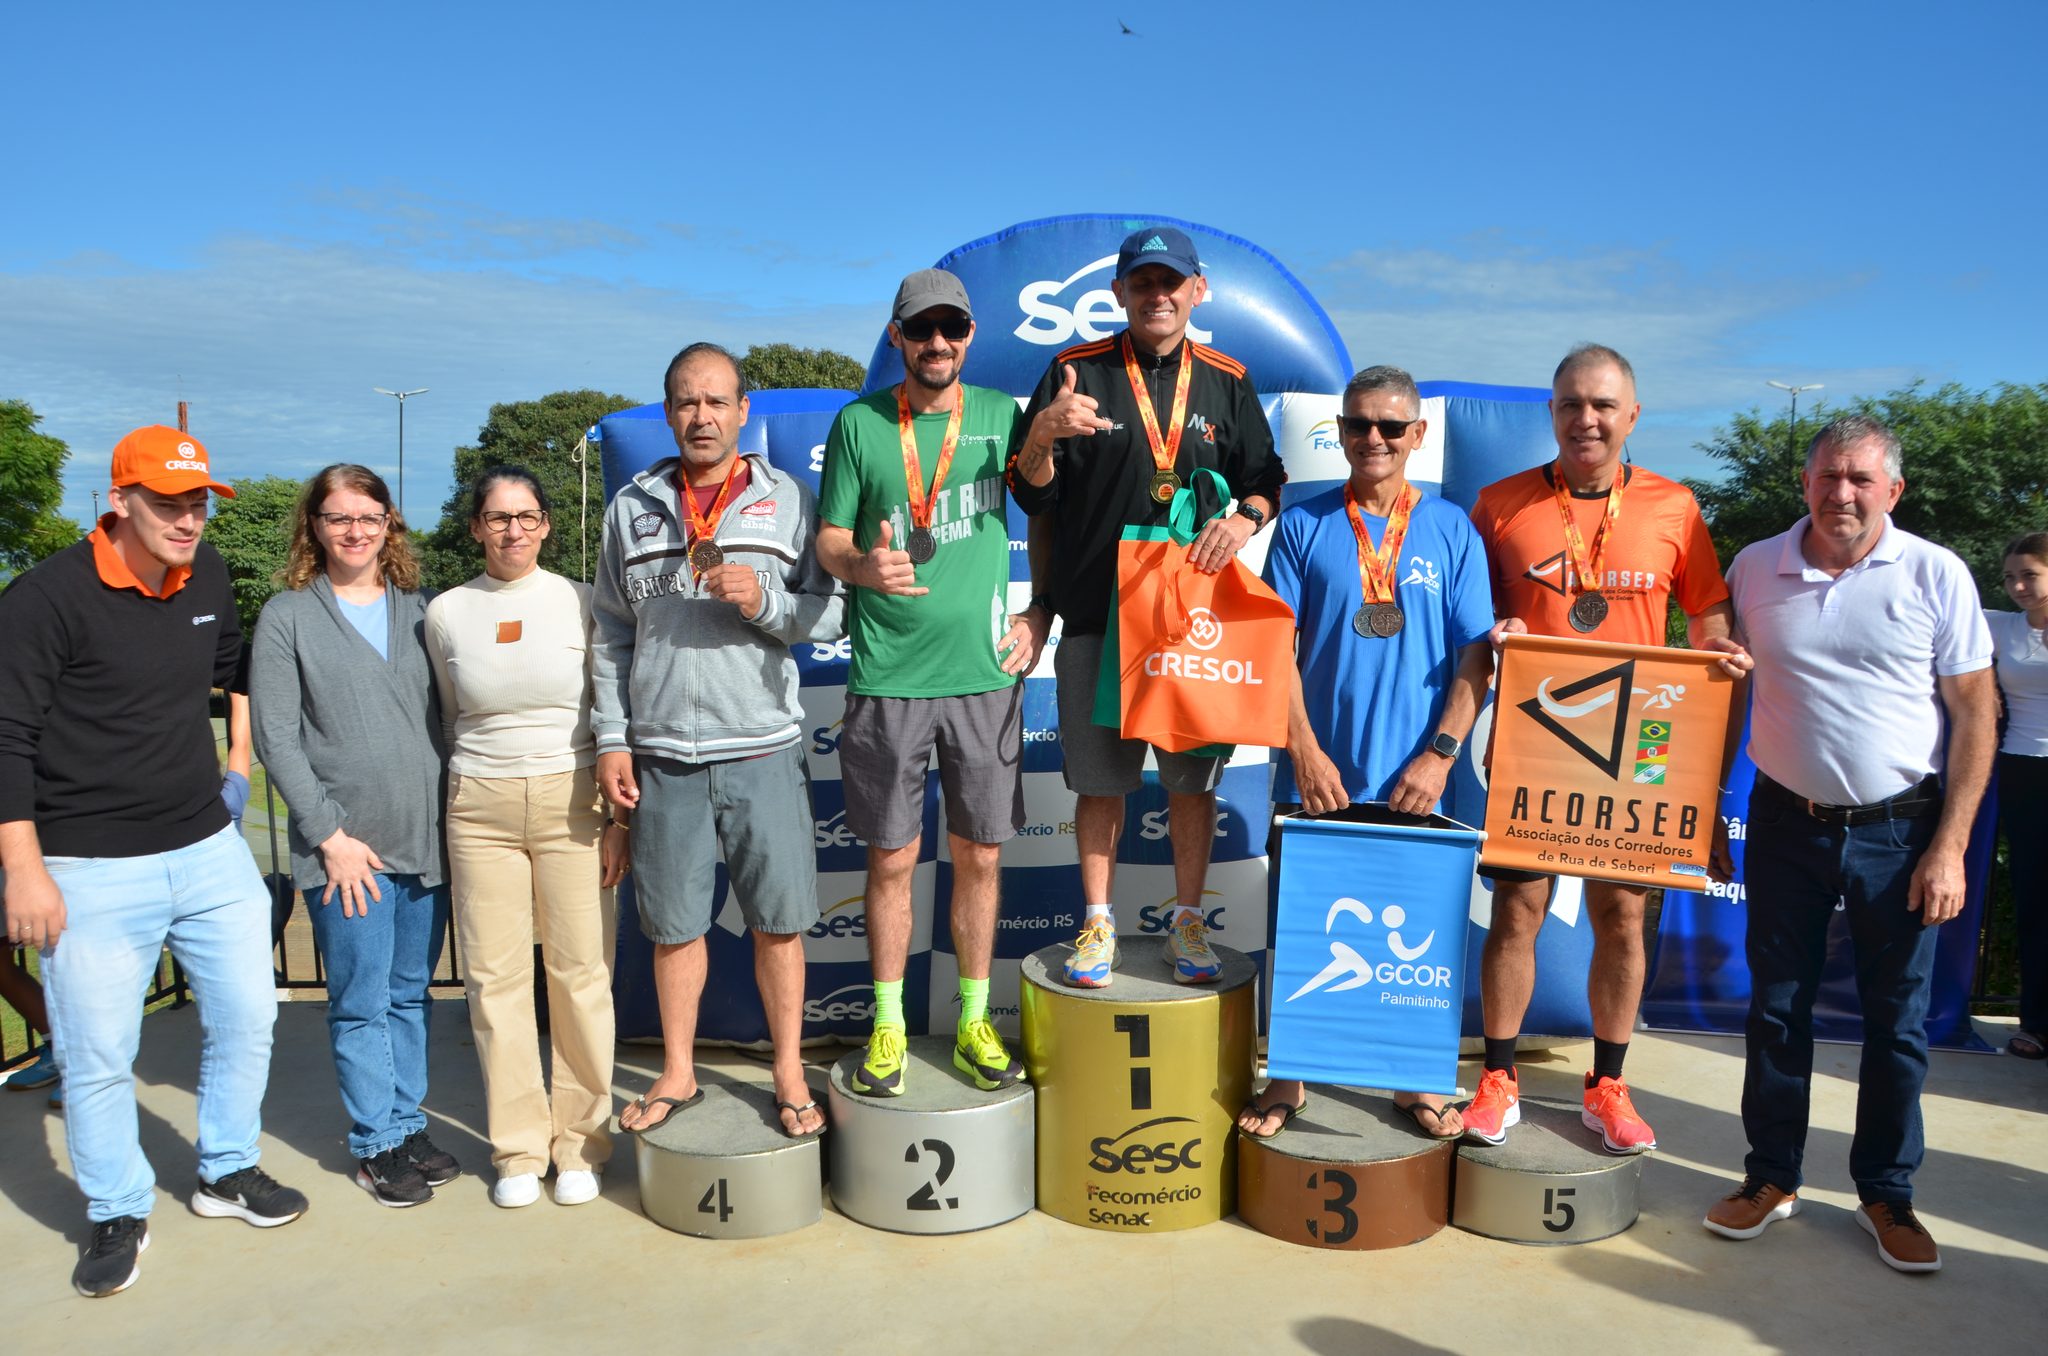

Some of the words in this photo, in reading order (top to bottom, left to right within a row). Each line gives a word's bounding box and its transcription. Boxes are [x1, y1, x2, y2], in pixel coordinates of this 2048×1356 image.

[1141, 243, 1168, 252] adidas
[931, 517, 973, 545] PEMA
[1144, 651, 1264, 685] CRESOL
[1510, 786, 1699, 840] ACORSEB
[1505, 825, 1581, 847] Associação
[1585, 833, 1610, 849] dos
[1614, 837, 1694, 859] Corredores
[1537, 850, 1555, 863] de
[1559, 852, 1585, 866] Rua
[1589, 856, 1607, 869] de
[1611, 858, 1656, 874] Seberi
[997, 915, 1050, 929] mércio
[1053, 913, 1075, 928] RS
[1375, 962, 1452, 988] GCOR
[1380, 991, 1450, 1009] Palmitinho
[1114, 1014, 1152, 1110] 1
[904, 1138, 959, 1211] 2
[697, 1178, 734, 1223] 4
[1088, 1185, 1202, 1205] Fecomércio
[1305, 1169, 1359, 1244] 3
[1542, 1187, 1576, 1233] 5
[1088, 1207, 1151, 1227] Senac
